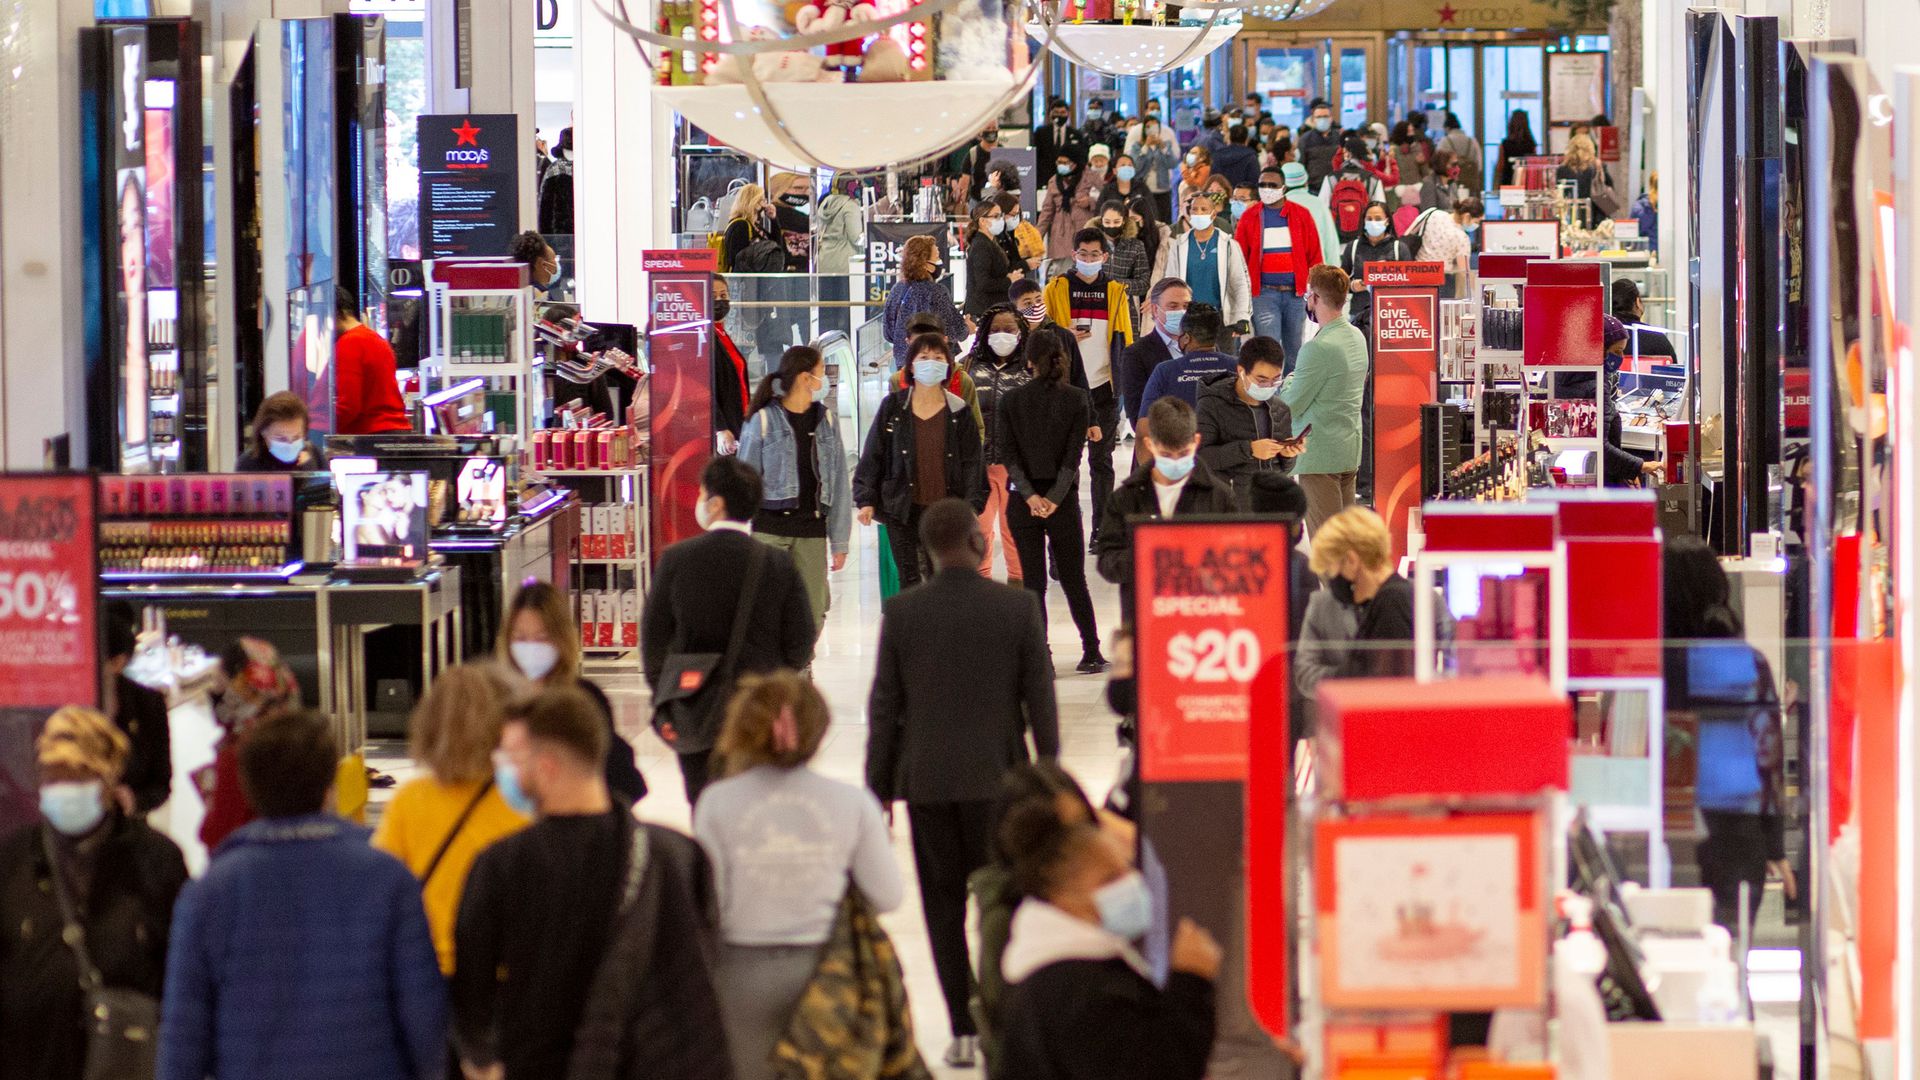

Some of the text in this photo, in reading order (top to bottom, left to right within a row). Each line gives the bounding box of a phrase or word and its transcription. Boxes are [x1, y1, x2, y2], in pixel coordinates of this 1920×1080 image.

[446, 149, 488, 163] macy's
[644, 260, 684, 269] SPECIAL
[1368, 265, 1441, 274] BLACK FRIDAY
[1368, 273, 1409, 282] SPECIAL
[655, 292, 685, 302] GIVE.
[663, 302, 696, 312] LOVE.
[1379, 309, 1410, 319] GIVE.
[1388, 319, 1422, 329] LOVE.
[1380, 329, 1432, 339] BELIEVE.
[1153, 546, 1266, 573] BLACK
[1154, 566, 1270, 596] FRIDAY
[1153, 597, 1243, 616] SPECIAL
[1167, 629, 1260, 681] $20
